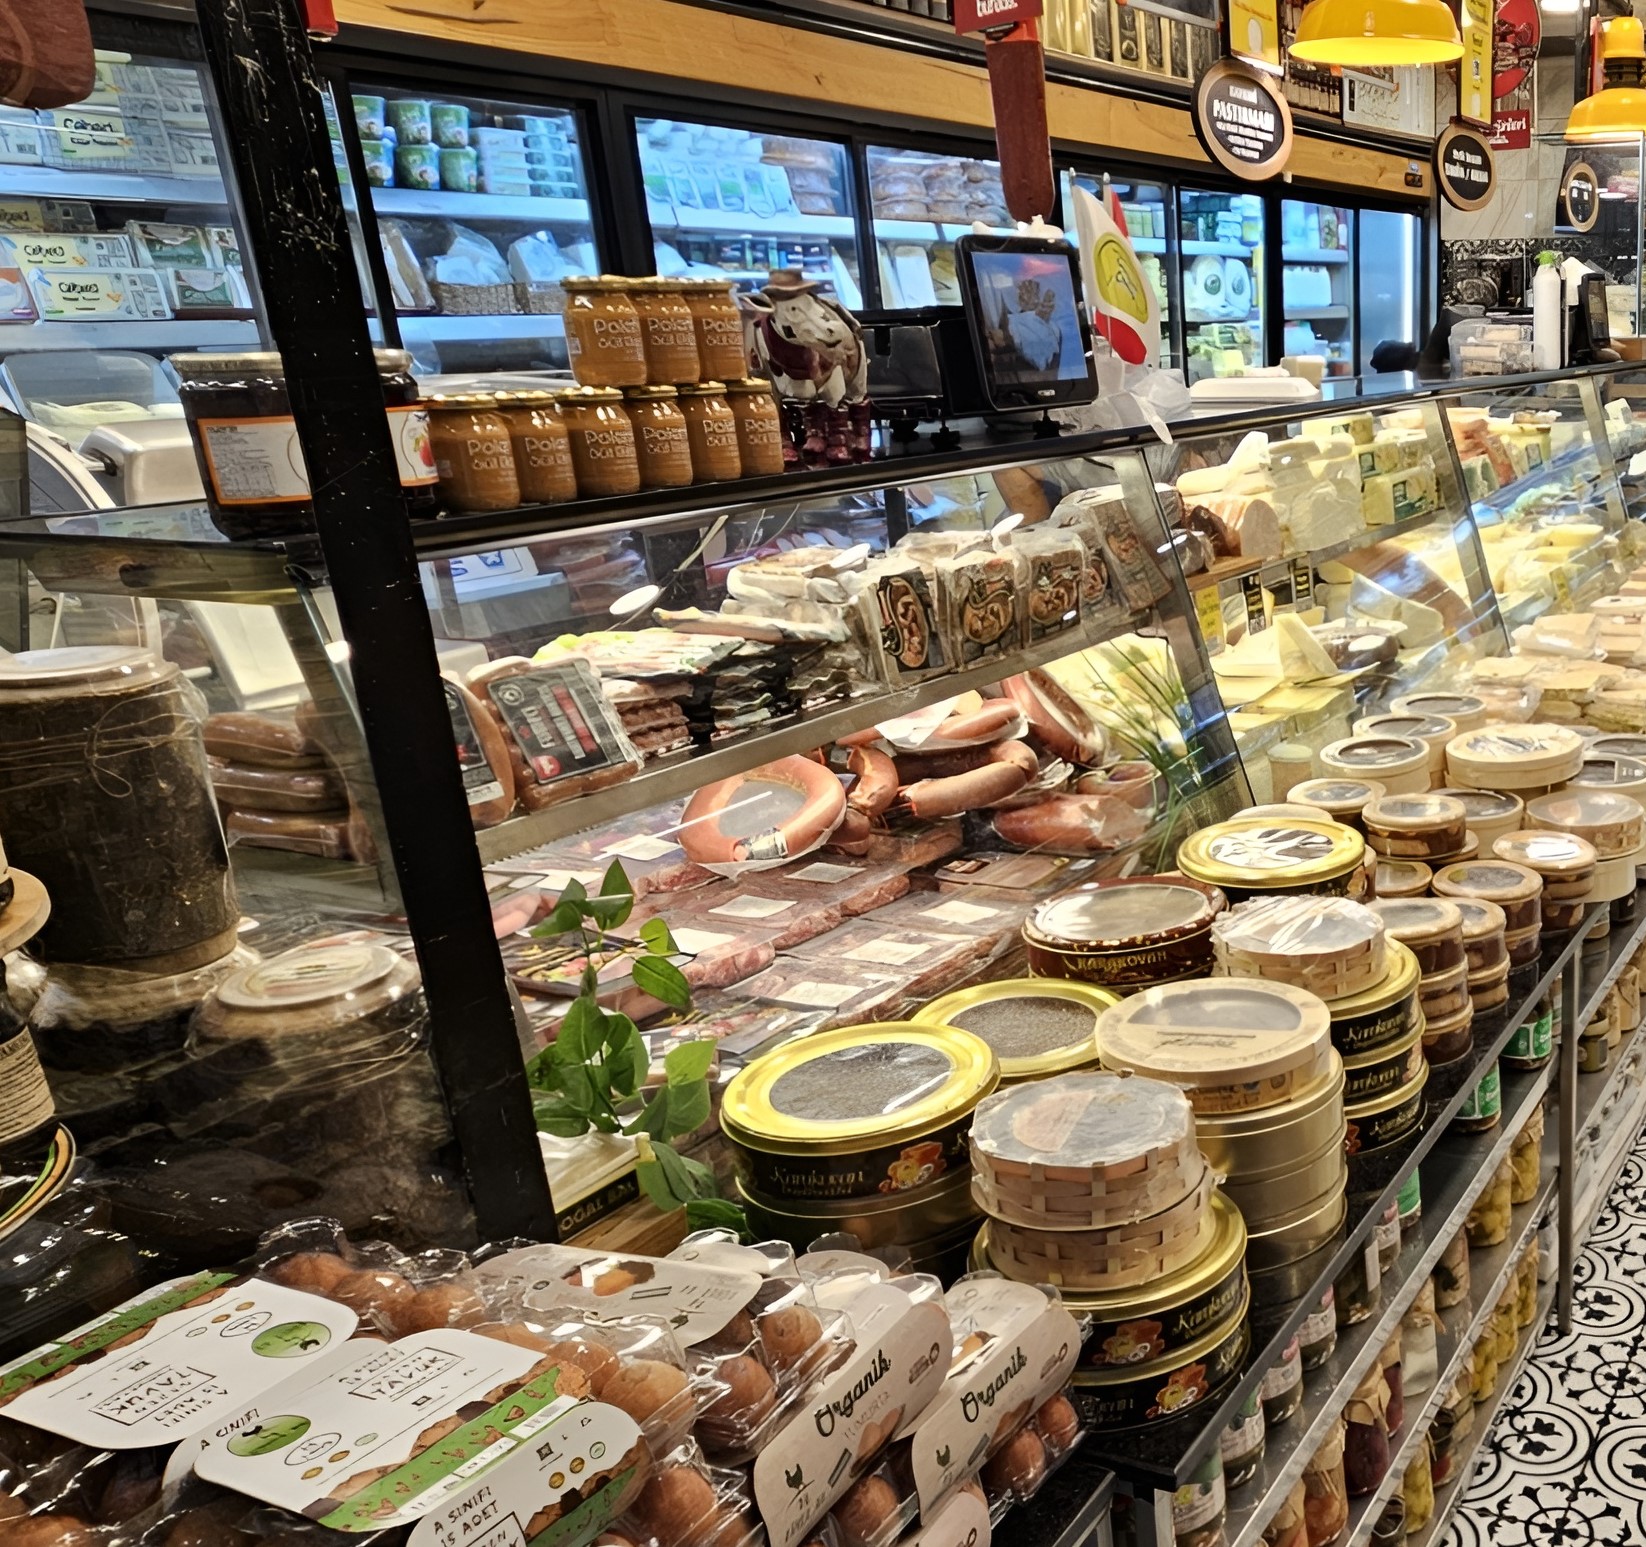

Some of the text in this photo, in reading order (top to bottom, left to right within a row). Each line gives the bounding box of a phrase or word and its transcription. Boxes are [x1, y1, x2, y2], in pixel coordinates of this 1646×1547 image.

[814, 1348, 893, 1437] Organik
[960, 1346, 1028, 1423] Organik
[434, 1486, 492, 1535] A SINIFI
[463, 1499, 499, 1535] ADET
